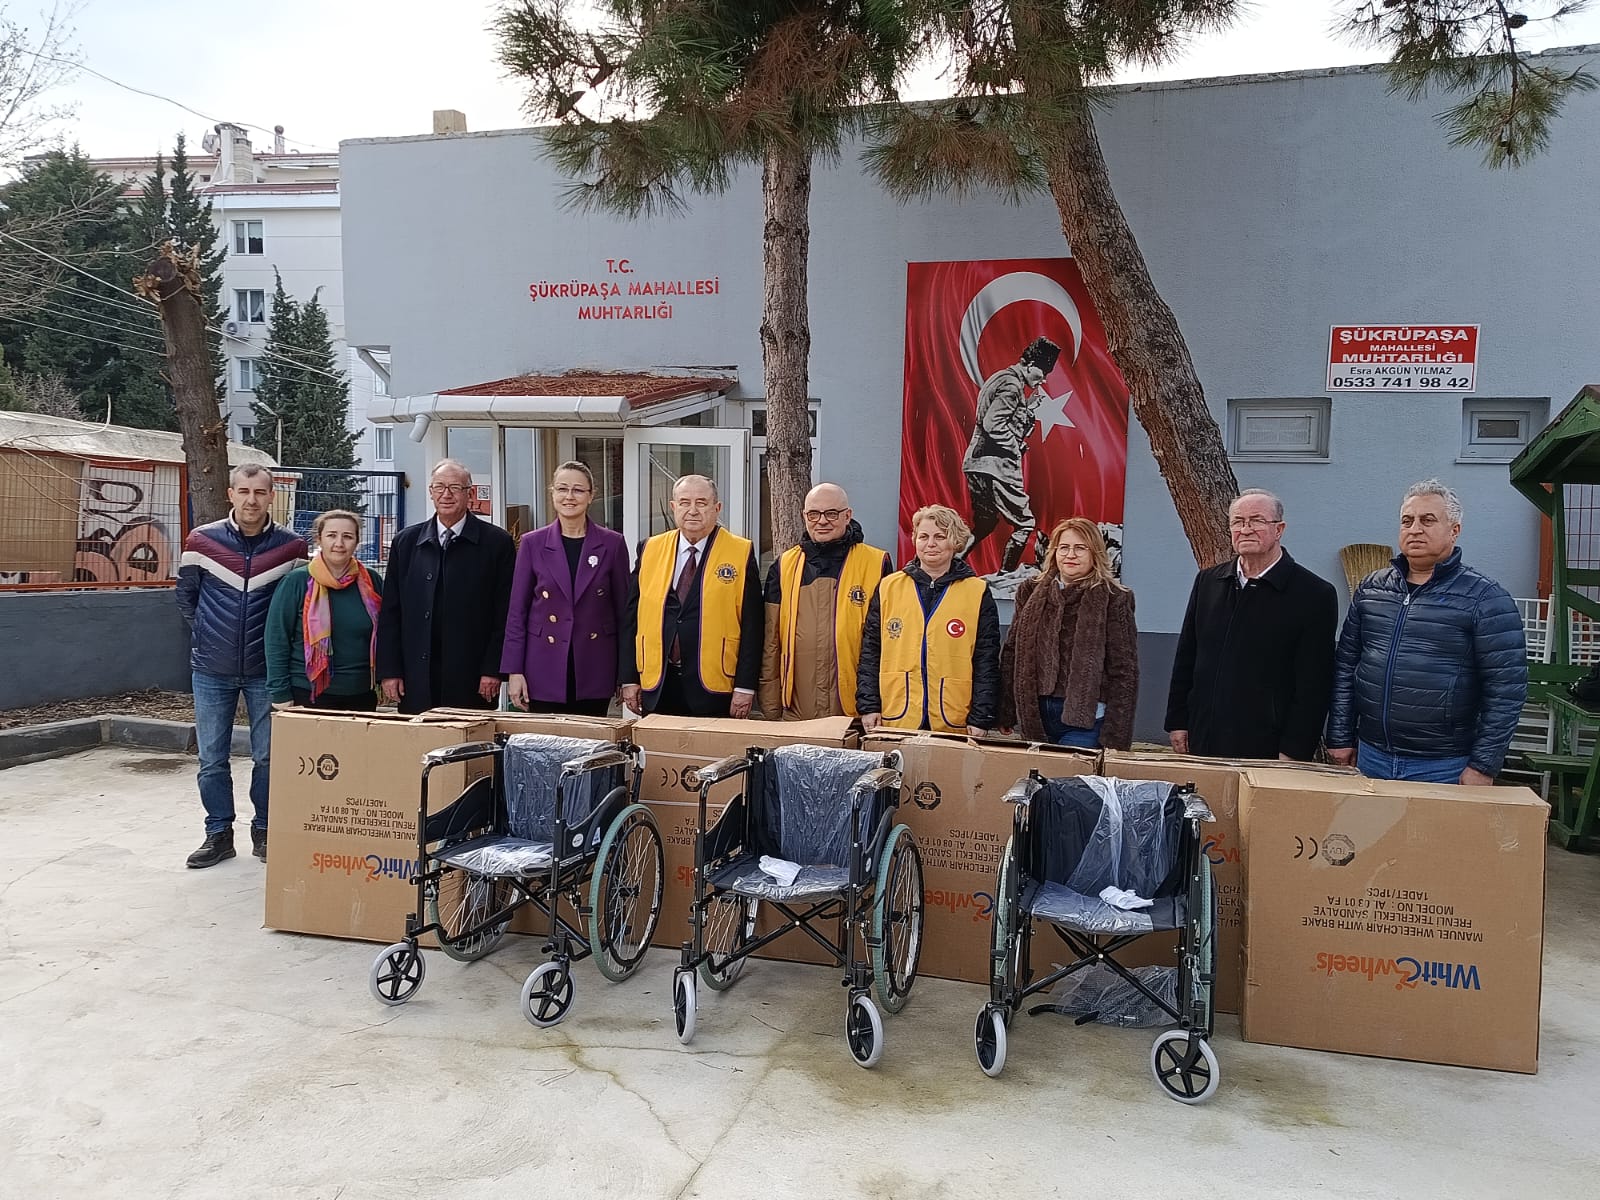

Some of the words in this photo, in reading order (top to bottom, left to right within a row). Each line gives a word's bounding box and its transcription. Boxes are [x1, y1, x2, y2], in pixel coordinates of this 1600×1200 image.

[606, 259, 635, 274] T.C.
[529, 280, 621, 302] ŞÜKRÜPAŞA
[628, 277, 719, 297] MAHALLESİ
[578, 301, 673, 320] MUHTARLIĞI
[1339, 327, 1469, 345] ŞÜKRÜPAŞA
[1370, 343, 1436, 352] MAHALLESİ
[1342, 352, 1463, 363] MUHTARLIĞI
[1350, 366, 1372, 375] Esra
[1414, 366, 1453, 375] YILMAZ
[1333, 377, 1375, 388] 0533
[1381, 377, 1412, 388] 741
[1419, 377, 1441, 388] 98
[1446, 377, 1469, 388] 42
[320, 804, 330, 814] FA
[350, 807, 359, 816] AL
[366, 809, 378, 818] NO
[311, 813, 349, 825] SANDALYE
[378, 810, 404, 820] MODEL
[303, 822, 326, 833] BRAKE
[326, 824, 345, 834] WITH
[345, 826, 391, 839] WHEELCHAIR
[392, 830, 417, 841] ANUEL
[666, 835, 691, 846] BRAKE
[918, 836, 930, 846] FA
[949, 829, 1000, 842] 1ADET/1PCS
[932, 837, 942, 847] 01
[954, 840, 965, 850] AL
[974, 842, 988, 852] NO
[926, 858, 948, 869] WITH
[949, 861, 998, 874] HEELCHAIR
[1366, 887, 1429, 901] 1ADET/1PCS
[1327, 895, 1341, 906] FA
[1345, 897, 1356, 907] 01
[1313, 905, 1369, 919] SANDALYE
[1397, 902, 1414, 913] NO
[1415, 903, 1454, 916] MODEL
[1301, 916, 1335, 929] BRAKE
[1374, 909, 1434, 926] TEKERLEKLİ
[1436, 916, 1472, 929] FRENLİ
[1338, 920, 1364, 931] WITH
[1366, 922, 1434, 939] WHEELCHAIR
[1437, 929, 1483, 943] MANUEL
